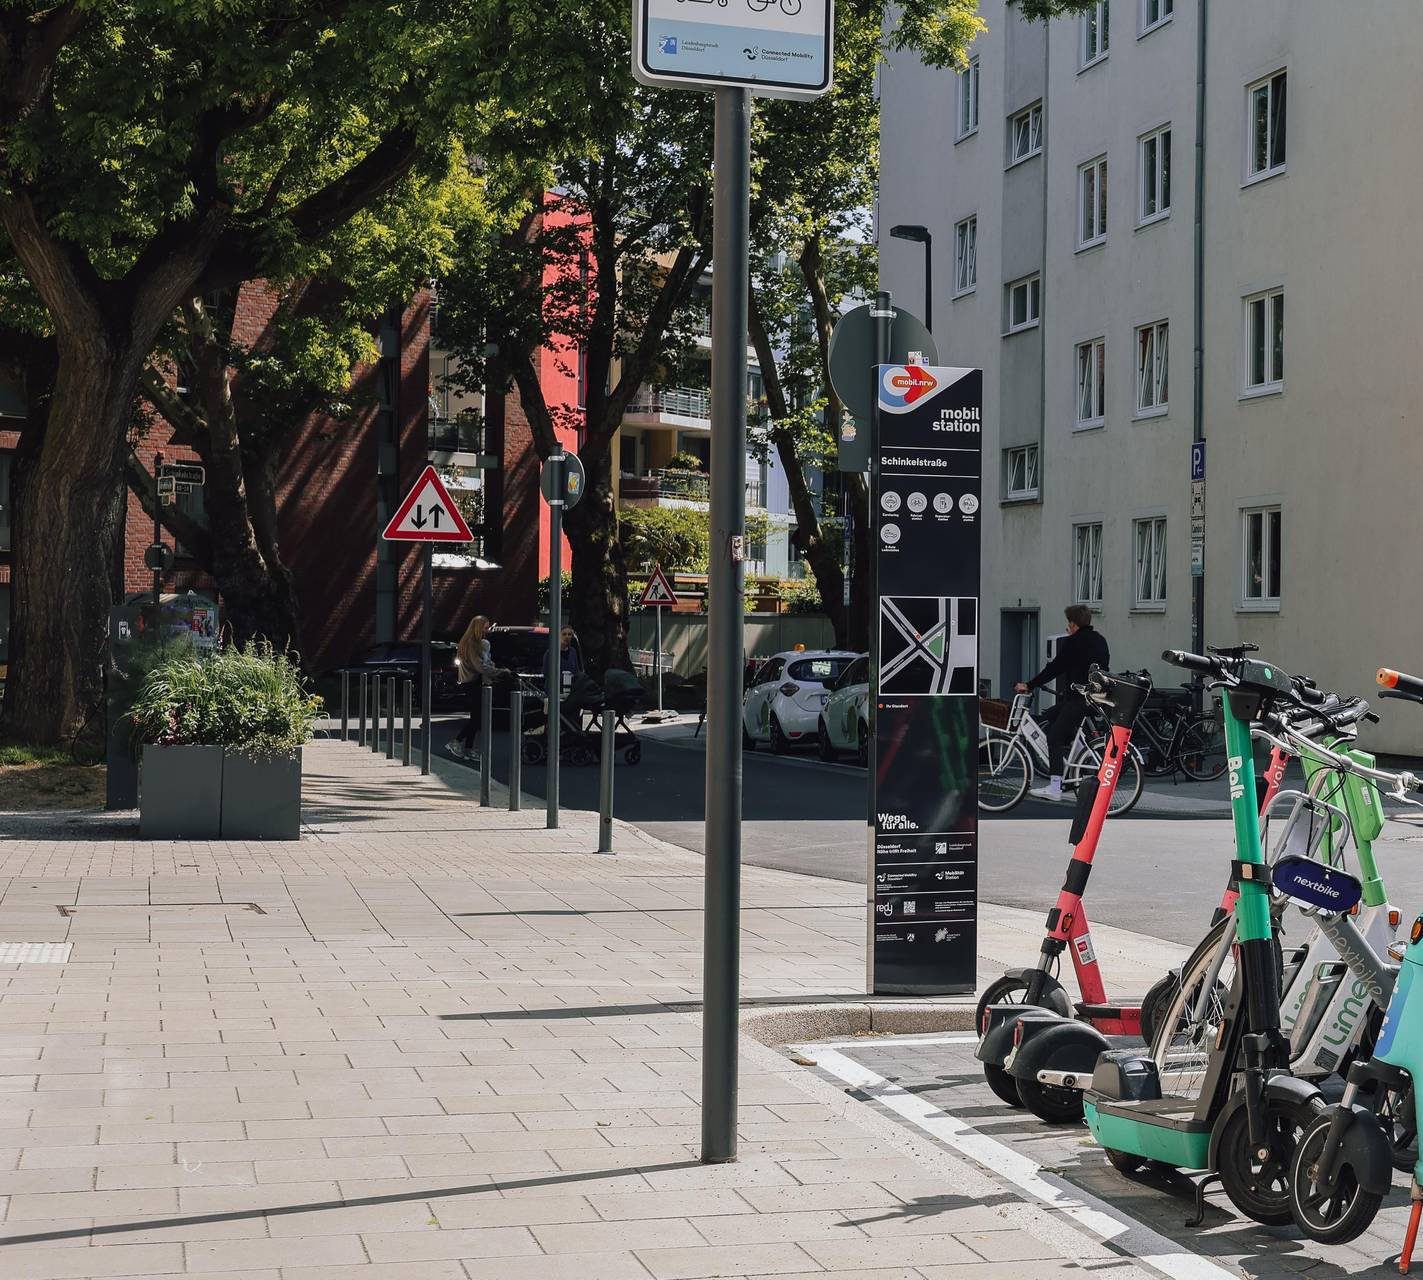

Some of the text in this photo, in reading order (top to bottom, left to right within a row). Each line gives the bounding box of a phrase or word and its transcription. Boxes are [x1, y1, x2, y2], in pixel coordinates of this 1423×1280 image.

[761, 48, 814, 61] Connected Mobility
[761, 55, 788, 63] Düsseldorf
[897, 378, 933, 387] mobil.nrw
[940, 407, 980, 420] mobil
[932, 420, 980, 433] station
[881, 457, 947, 468] Schinkelstraße
[1193, 448, 1201, 476] P
[1228, 755, 1244, 800] Bolt
[877, 813, 907, 824] Wege
[882, 820, 919, 830] für alle.
[1294, 873, 1340, 899] nextbike
[876, 902, 893, 917] redy
[1326, 925, 1388, 997] nextbike
[1322, 979, 1369, 1046] Lime
